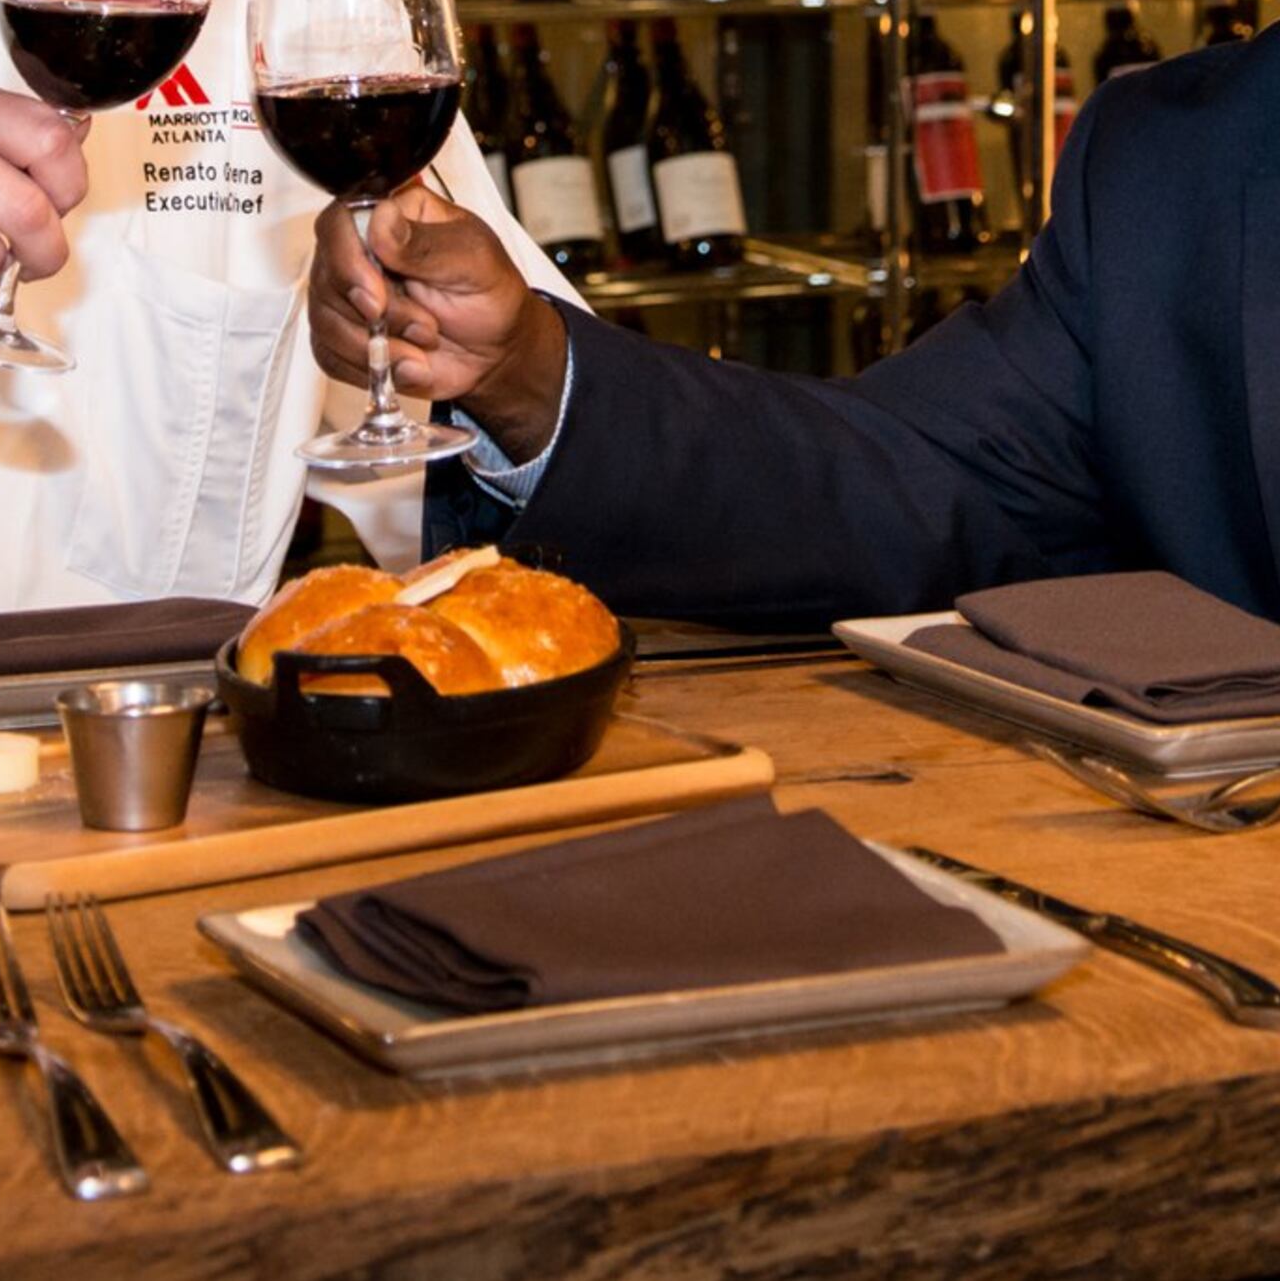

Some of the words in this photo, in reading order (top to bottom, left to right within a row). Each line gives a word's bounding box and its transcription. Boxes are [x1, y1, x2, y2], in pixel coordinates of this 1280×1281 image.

[148, 109, 229, 127] MARRIOTT
[151, 129, 226, 145] ATLANTA
[143, 161, 218, 183] Renato
